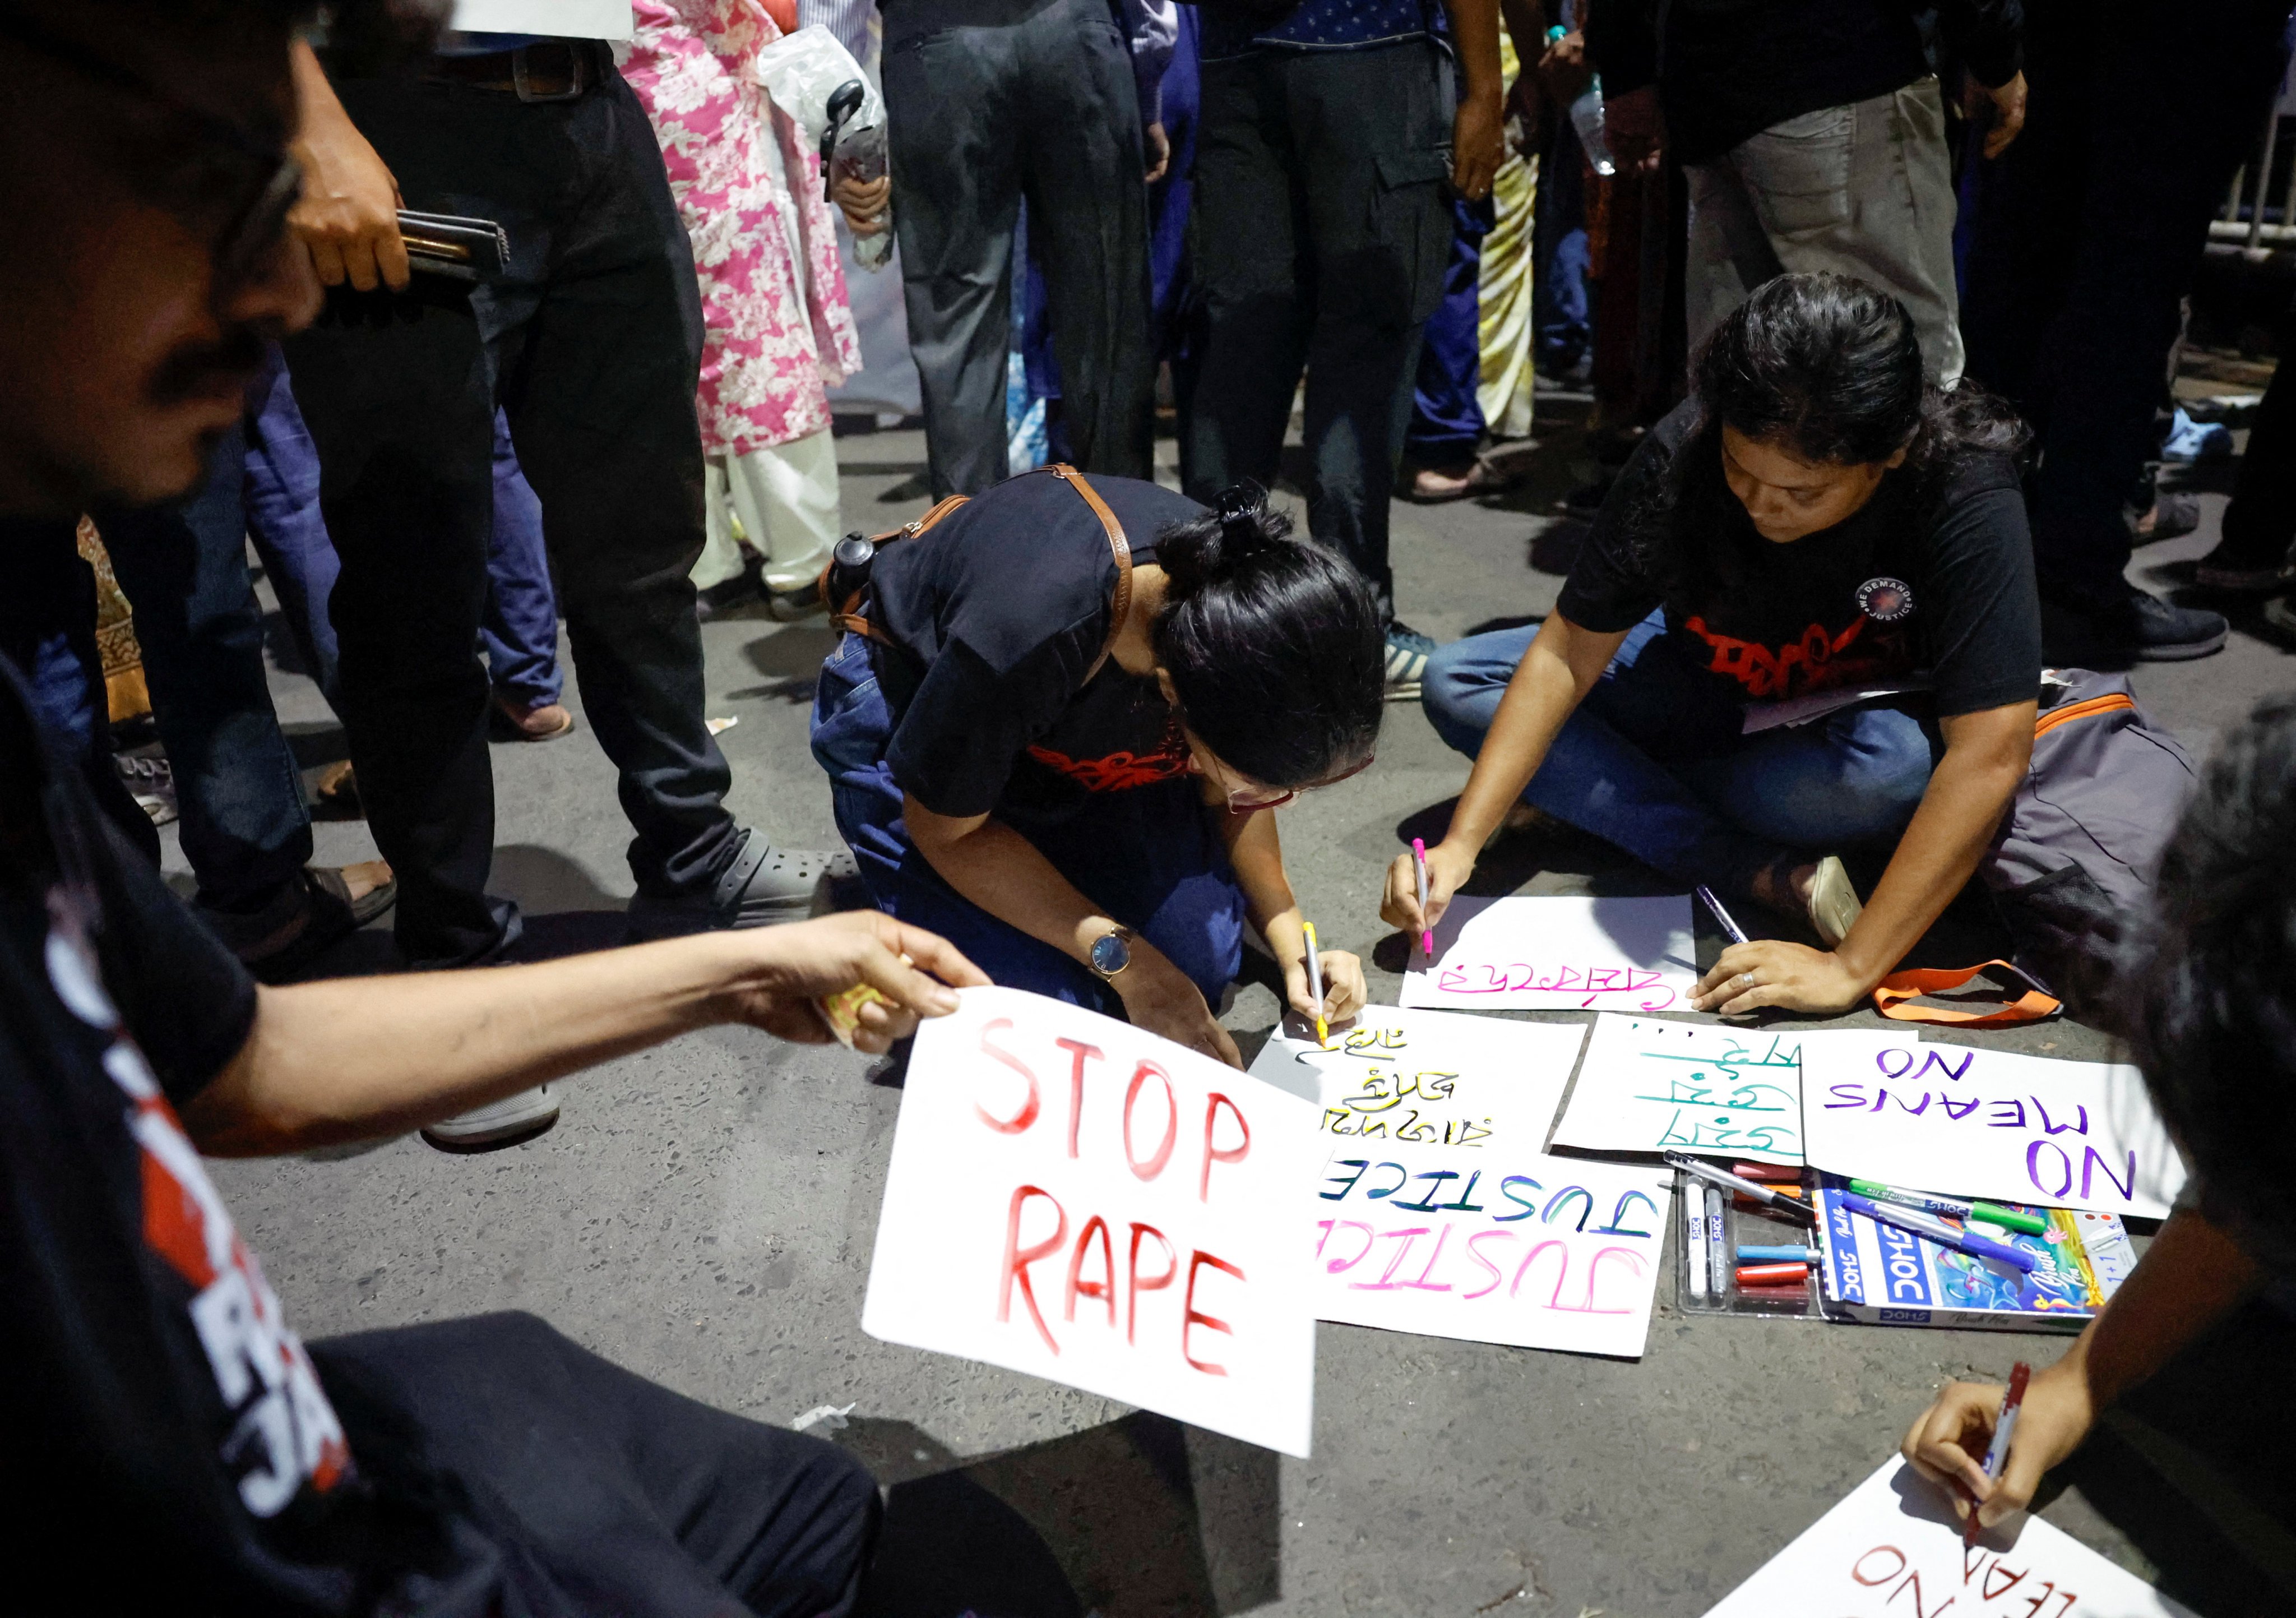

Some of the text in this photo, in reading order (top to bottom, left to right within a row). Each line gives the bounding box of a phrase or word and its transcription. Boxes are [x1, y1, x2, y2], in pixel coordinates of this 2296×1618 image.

[1859, 581, 1911, 608] WE DEMAND
[1869, 603, 1913, 621] JUSTICE
[1438, 963, 1676, 1011] ধর্ষকদের
[1876, 1049, 1974, 1081] NO
[974, 1017, 1251, 1204] STOP
[1823, 1084, 2088, 1135] MEANS
[2026, 1140, 2135, 1200] NO
[1318, 1159, 1658, 1238] JUSTICE
[1930, 1201, 1968, 1217] DOMS
[1692, 1218, 1701, 1240] DOMS
[1712, 1215, 1723, 1241] DOMS
[996, 1185, 1247, 1377] RAPE
[1840, 1250, 1862, 1297] DOMS
[1882, 1224, 1924, 1300] DOMS
[2020, 1242, 2070, 1296] Brush
[2059, 1267, 2085, 1287] Pen
[1882, 1310, 1927, 1321] DOMS
[1851, 1545, 1956, 1618] NO
